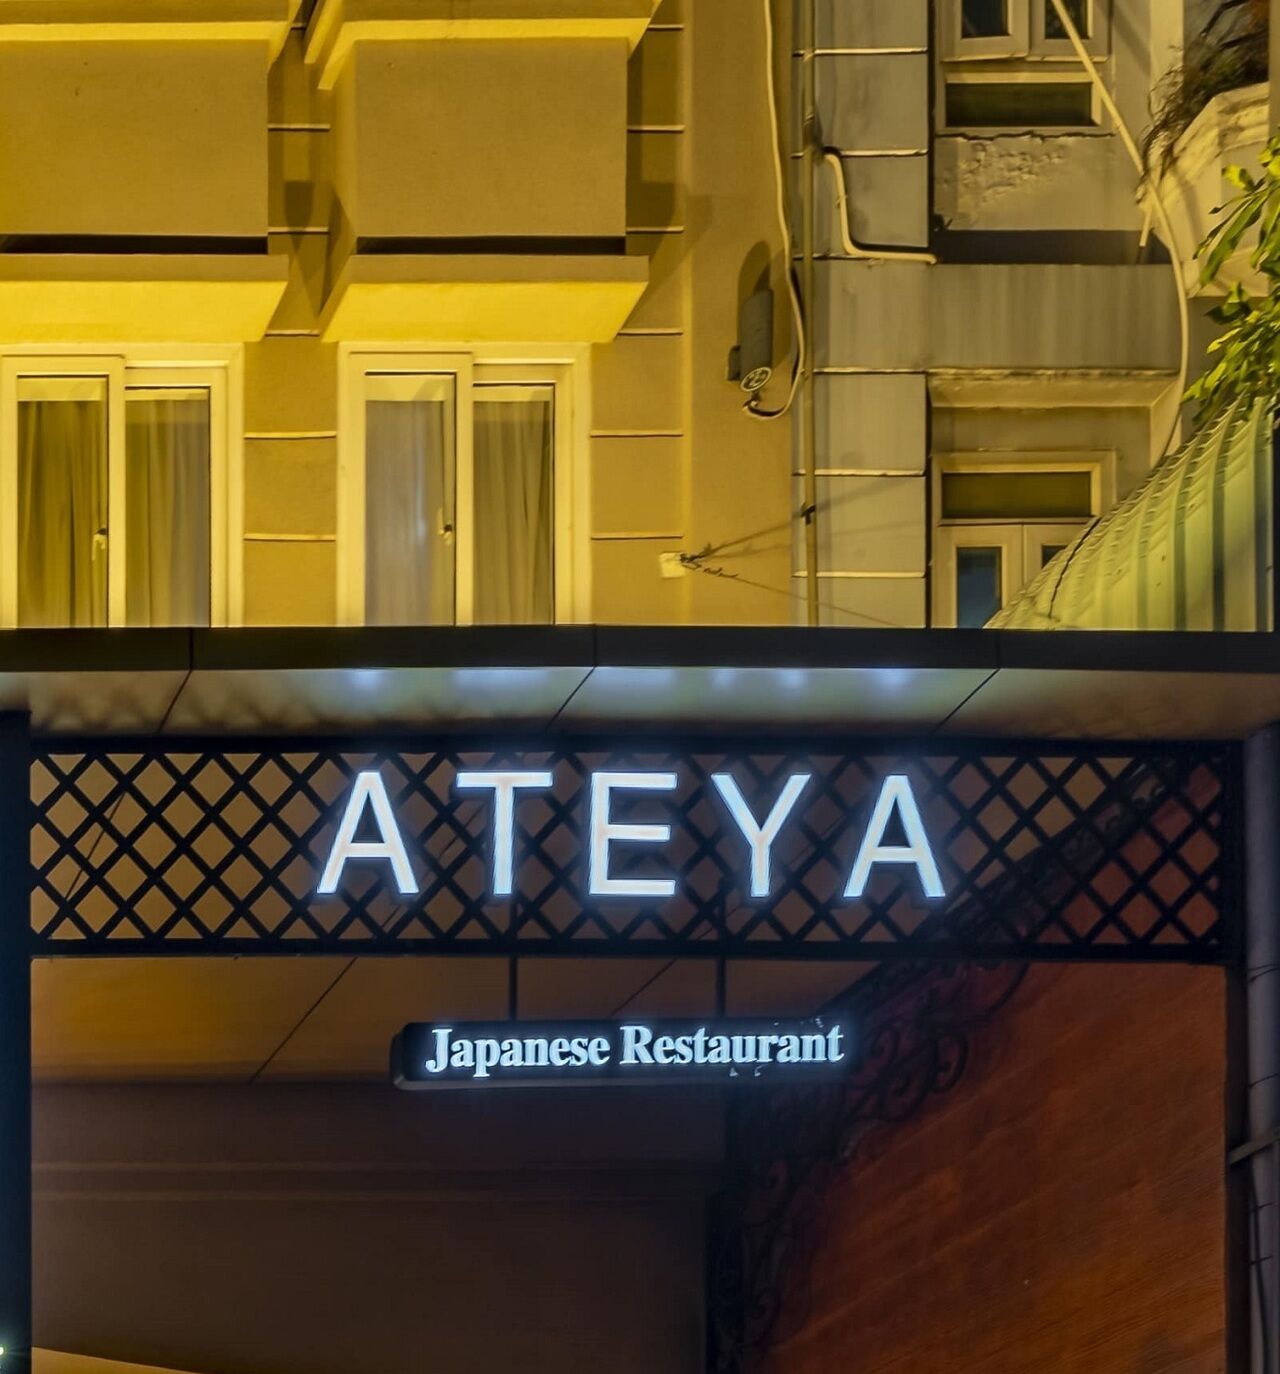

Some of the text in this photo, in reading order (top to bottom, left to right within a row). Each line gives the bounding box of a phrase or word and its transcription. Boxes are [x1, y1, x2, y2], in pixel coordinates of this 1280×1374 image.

[316, 771, 946, 898] ATEYA
[425, 1024, 845, 1078] Japanese Restaurant
